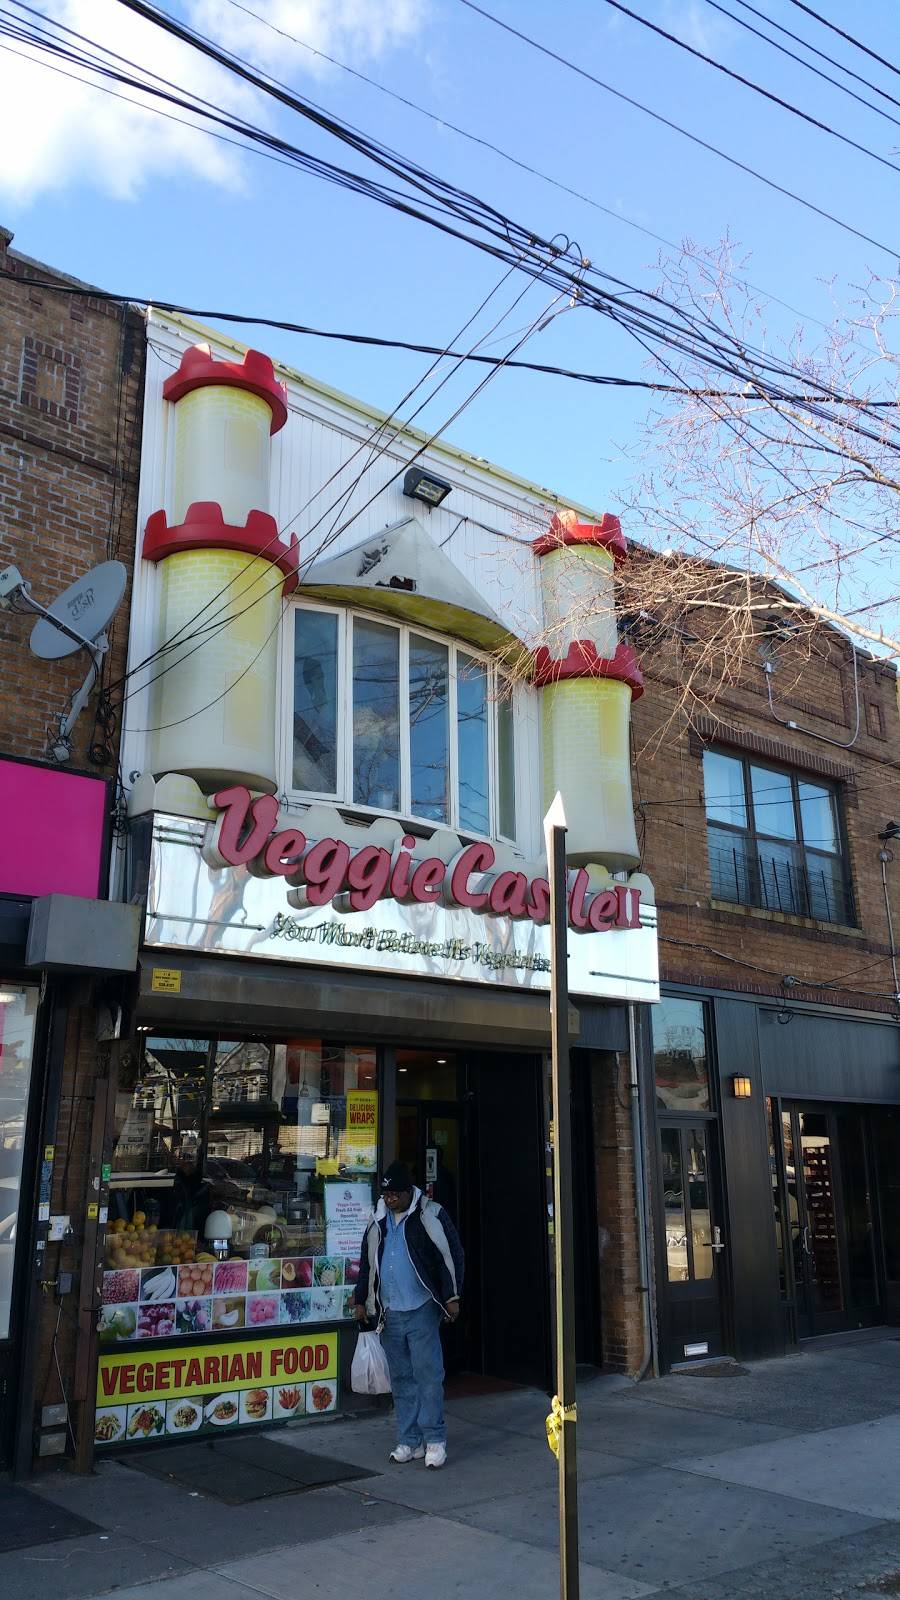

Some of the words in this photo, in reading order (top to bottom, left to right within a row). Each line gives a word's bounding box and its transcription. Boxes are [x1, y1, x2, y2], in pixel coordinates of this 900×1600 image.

[213, 785, 447, 912] Veggie
[451, 841, 619, 932] Casle
[270, 912, 317, 943] You
[349, 1111, 375, 1124] WRAPS
[101, 1351, 263, 1396] VEGETARIAN
[270, 1344, 330, 1377] FOOD
